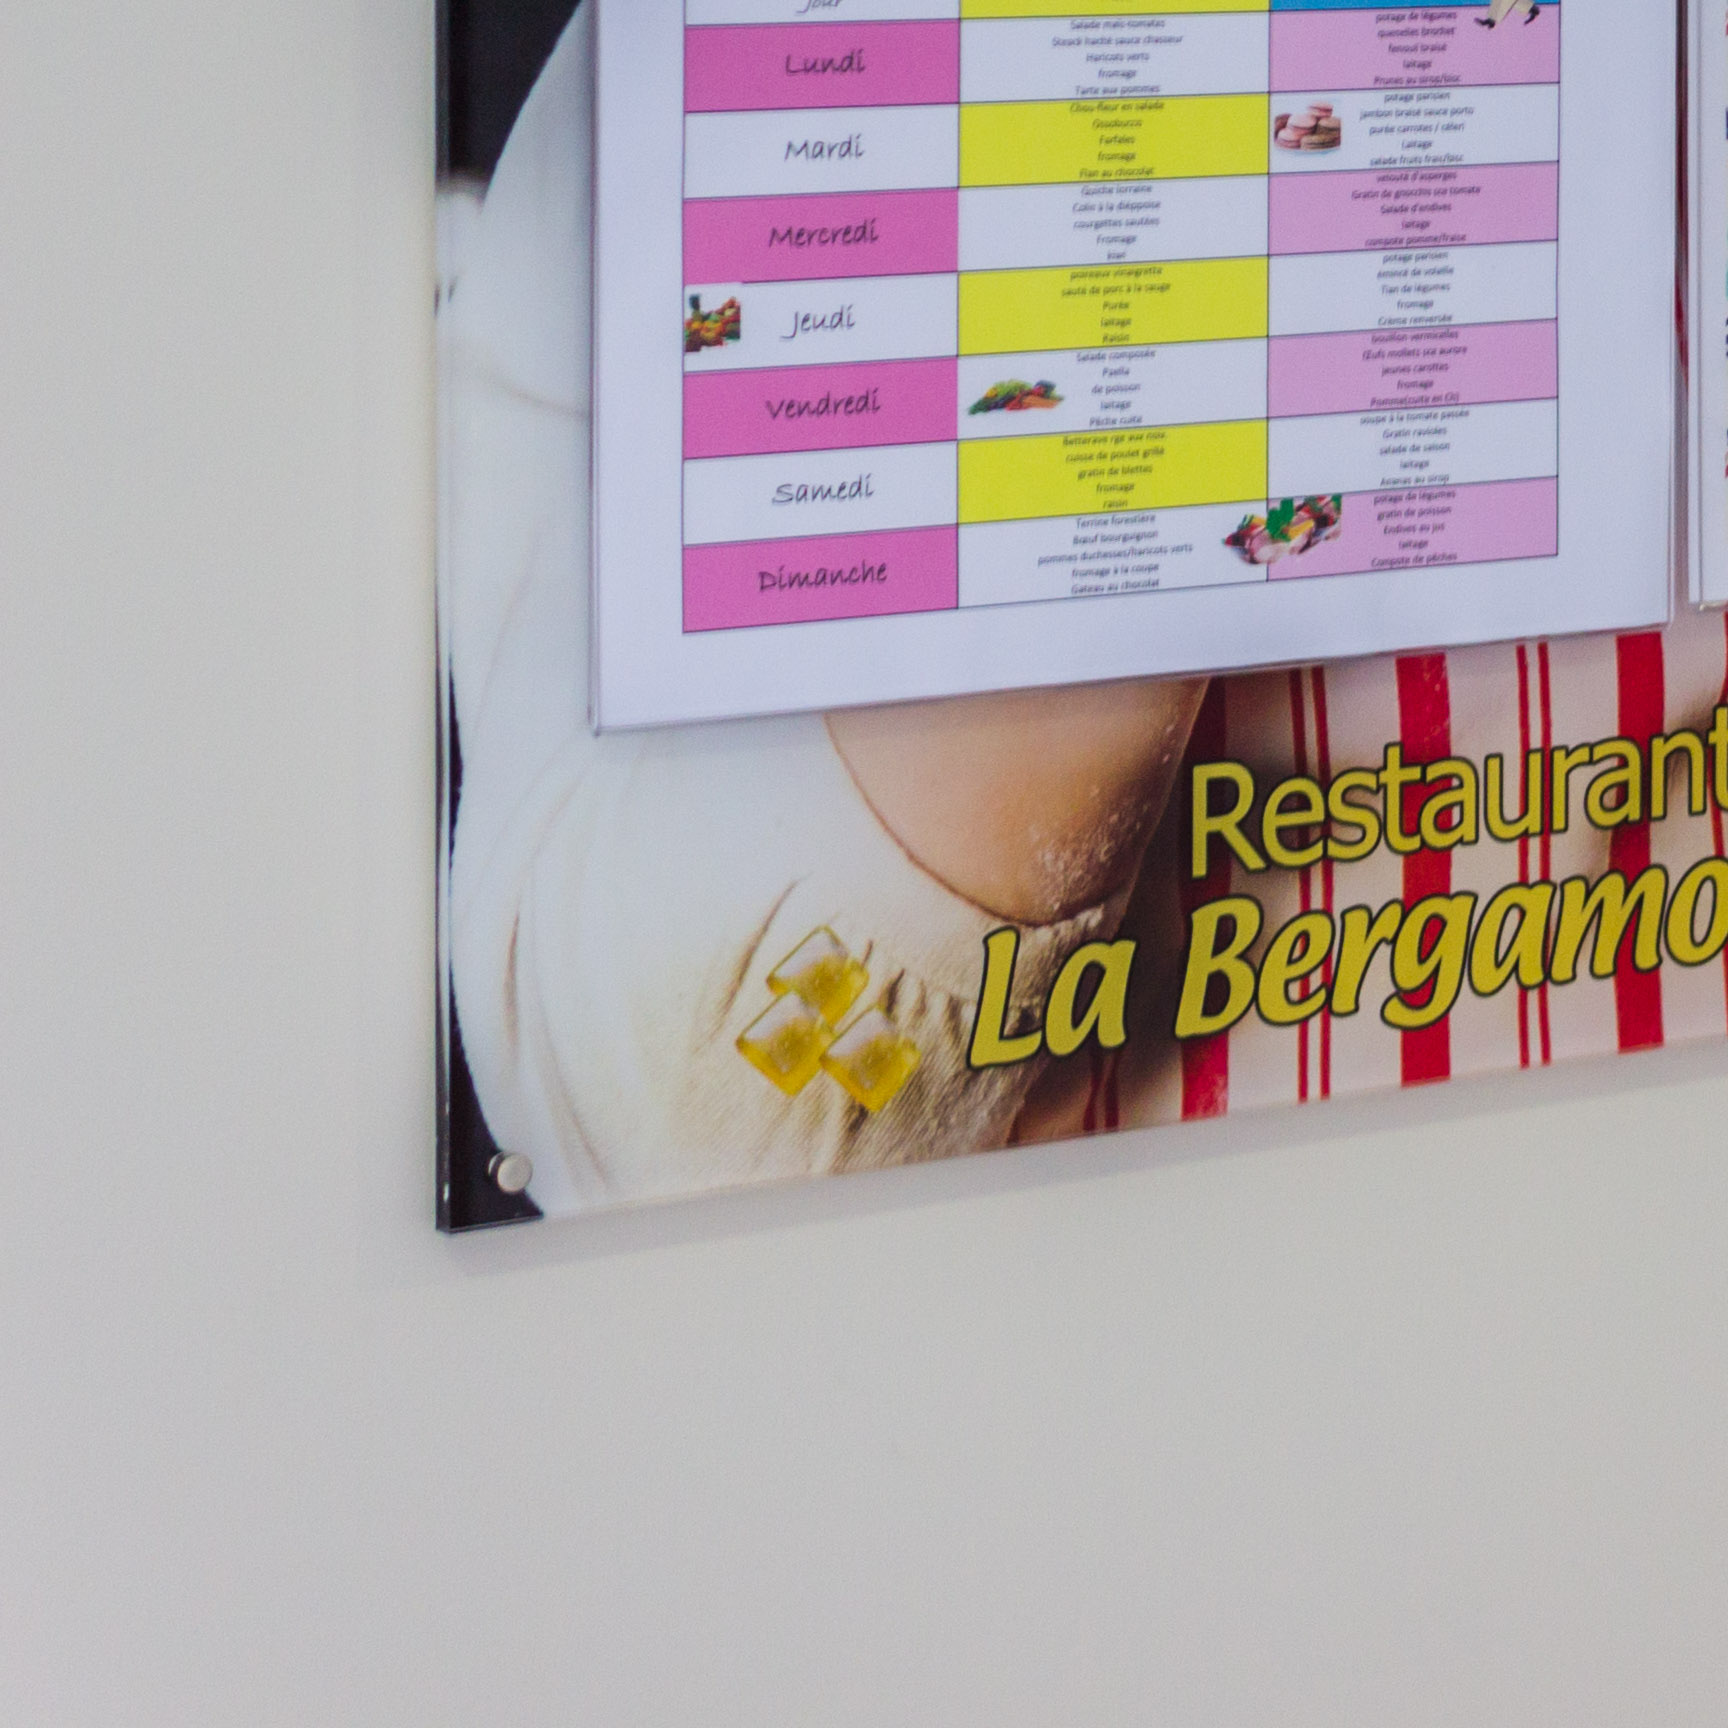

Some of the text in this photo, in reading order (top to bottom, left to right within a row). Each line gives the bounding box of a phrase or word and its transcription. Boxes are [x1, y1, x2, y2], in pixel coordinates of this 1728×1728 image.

[782, 47, 868, 79] Lundi
[782, 132, 867, 165] Mardi
[765, 218, 881, 251] Mercredi
[779, 303, 858, 342] Jeudi
[763, 386, 883, 421] Vendredi
[770, 471, 876, 506] Samedi
[757, 557, 890, 594] Dimanche
[964, 925, 1138, 1071] La
